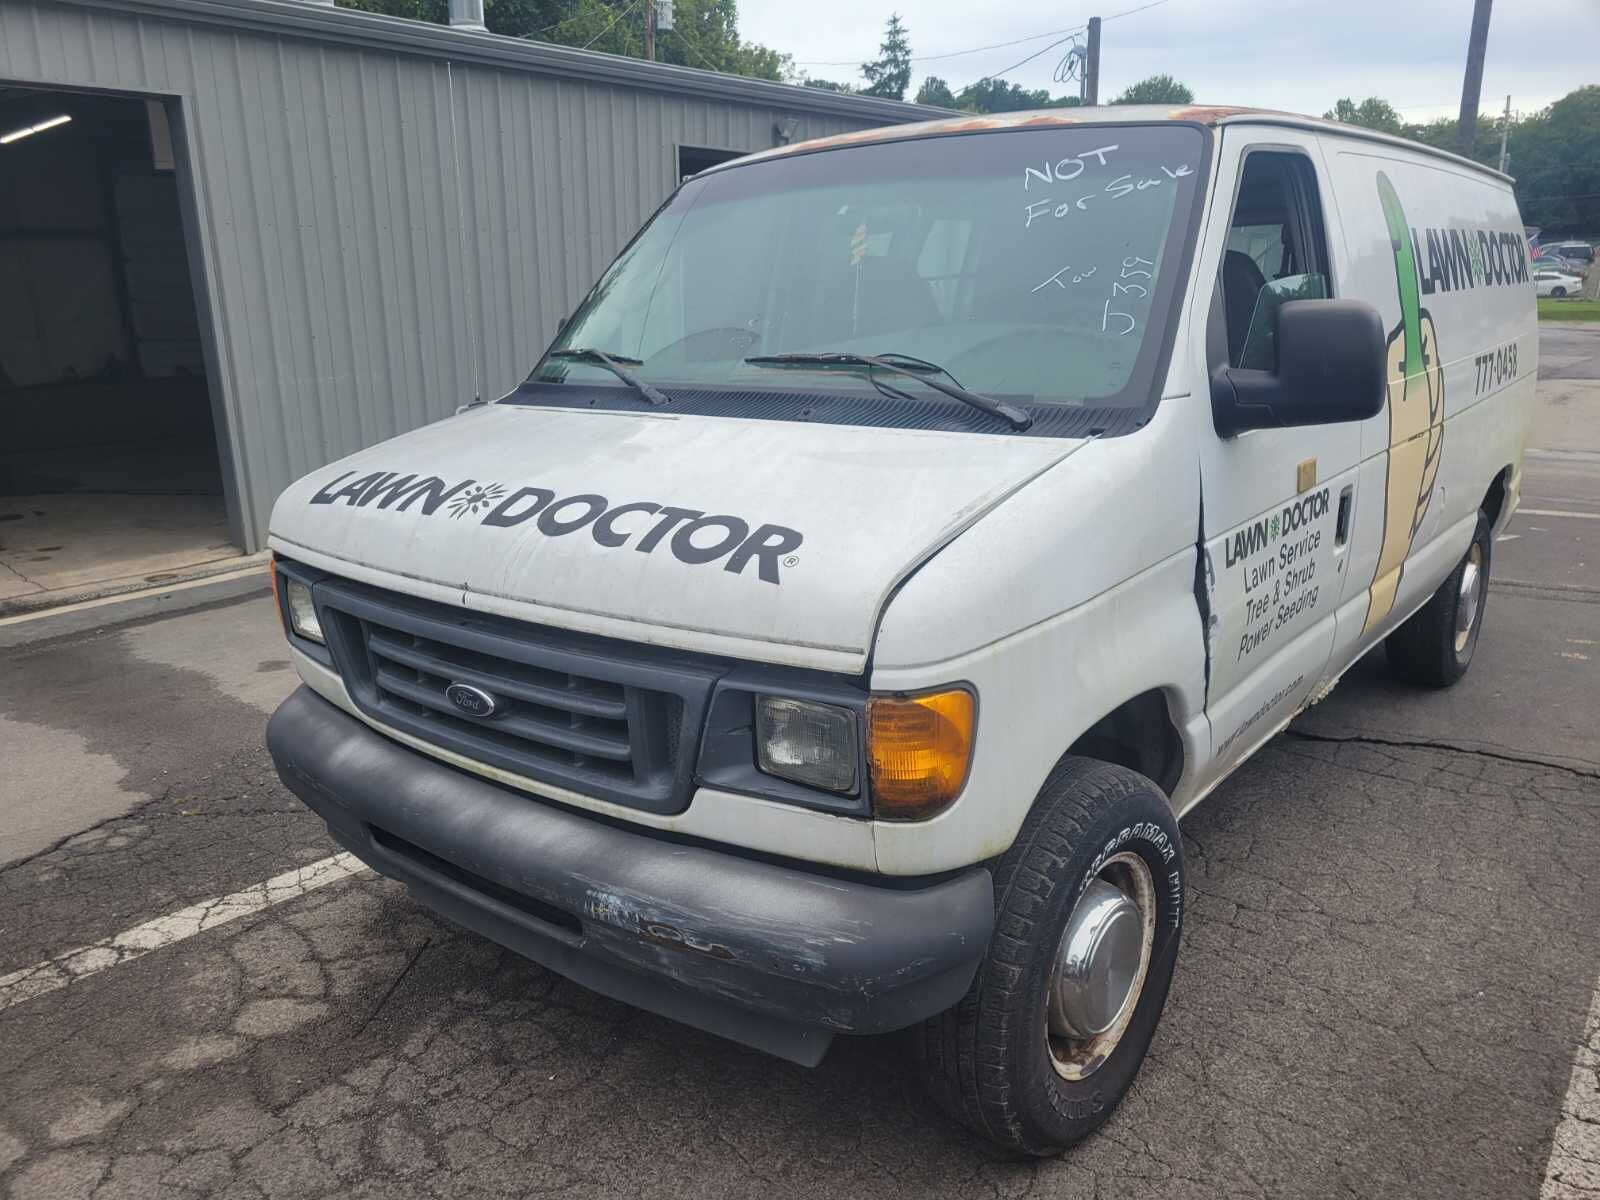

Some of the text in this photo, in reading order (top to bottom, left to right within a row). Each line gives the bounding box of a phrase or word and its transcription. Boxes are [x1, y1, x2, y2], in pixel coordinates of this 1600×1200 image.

[1024, 144, 1120, 191] NOT
[1024, 163, 1195, 229] For Sale
[1031, 265, 1097, 293] Tow
[1411, 227, 1529, 295] LAWN DOCTOR
[1474, 343, 1519, 396] 777-0458
[308, 470, 805, 586] LAWN DOCTOR
[1225, 487, 1330, 569] LAWN DOCTOR
[1243, 529, 1321, 594] Lawn Service
[1237, 585, 1319, 664] Power Seeding
[1246, 557, 1316, 627] Tree & Shrub
